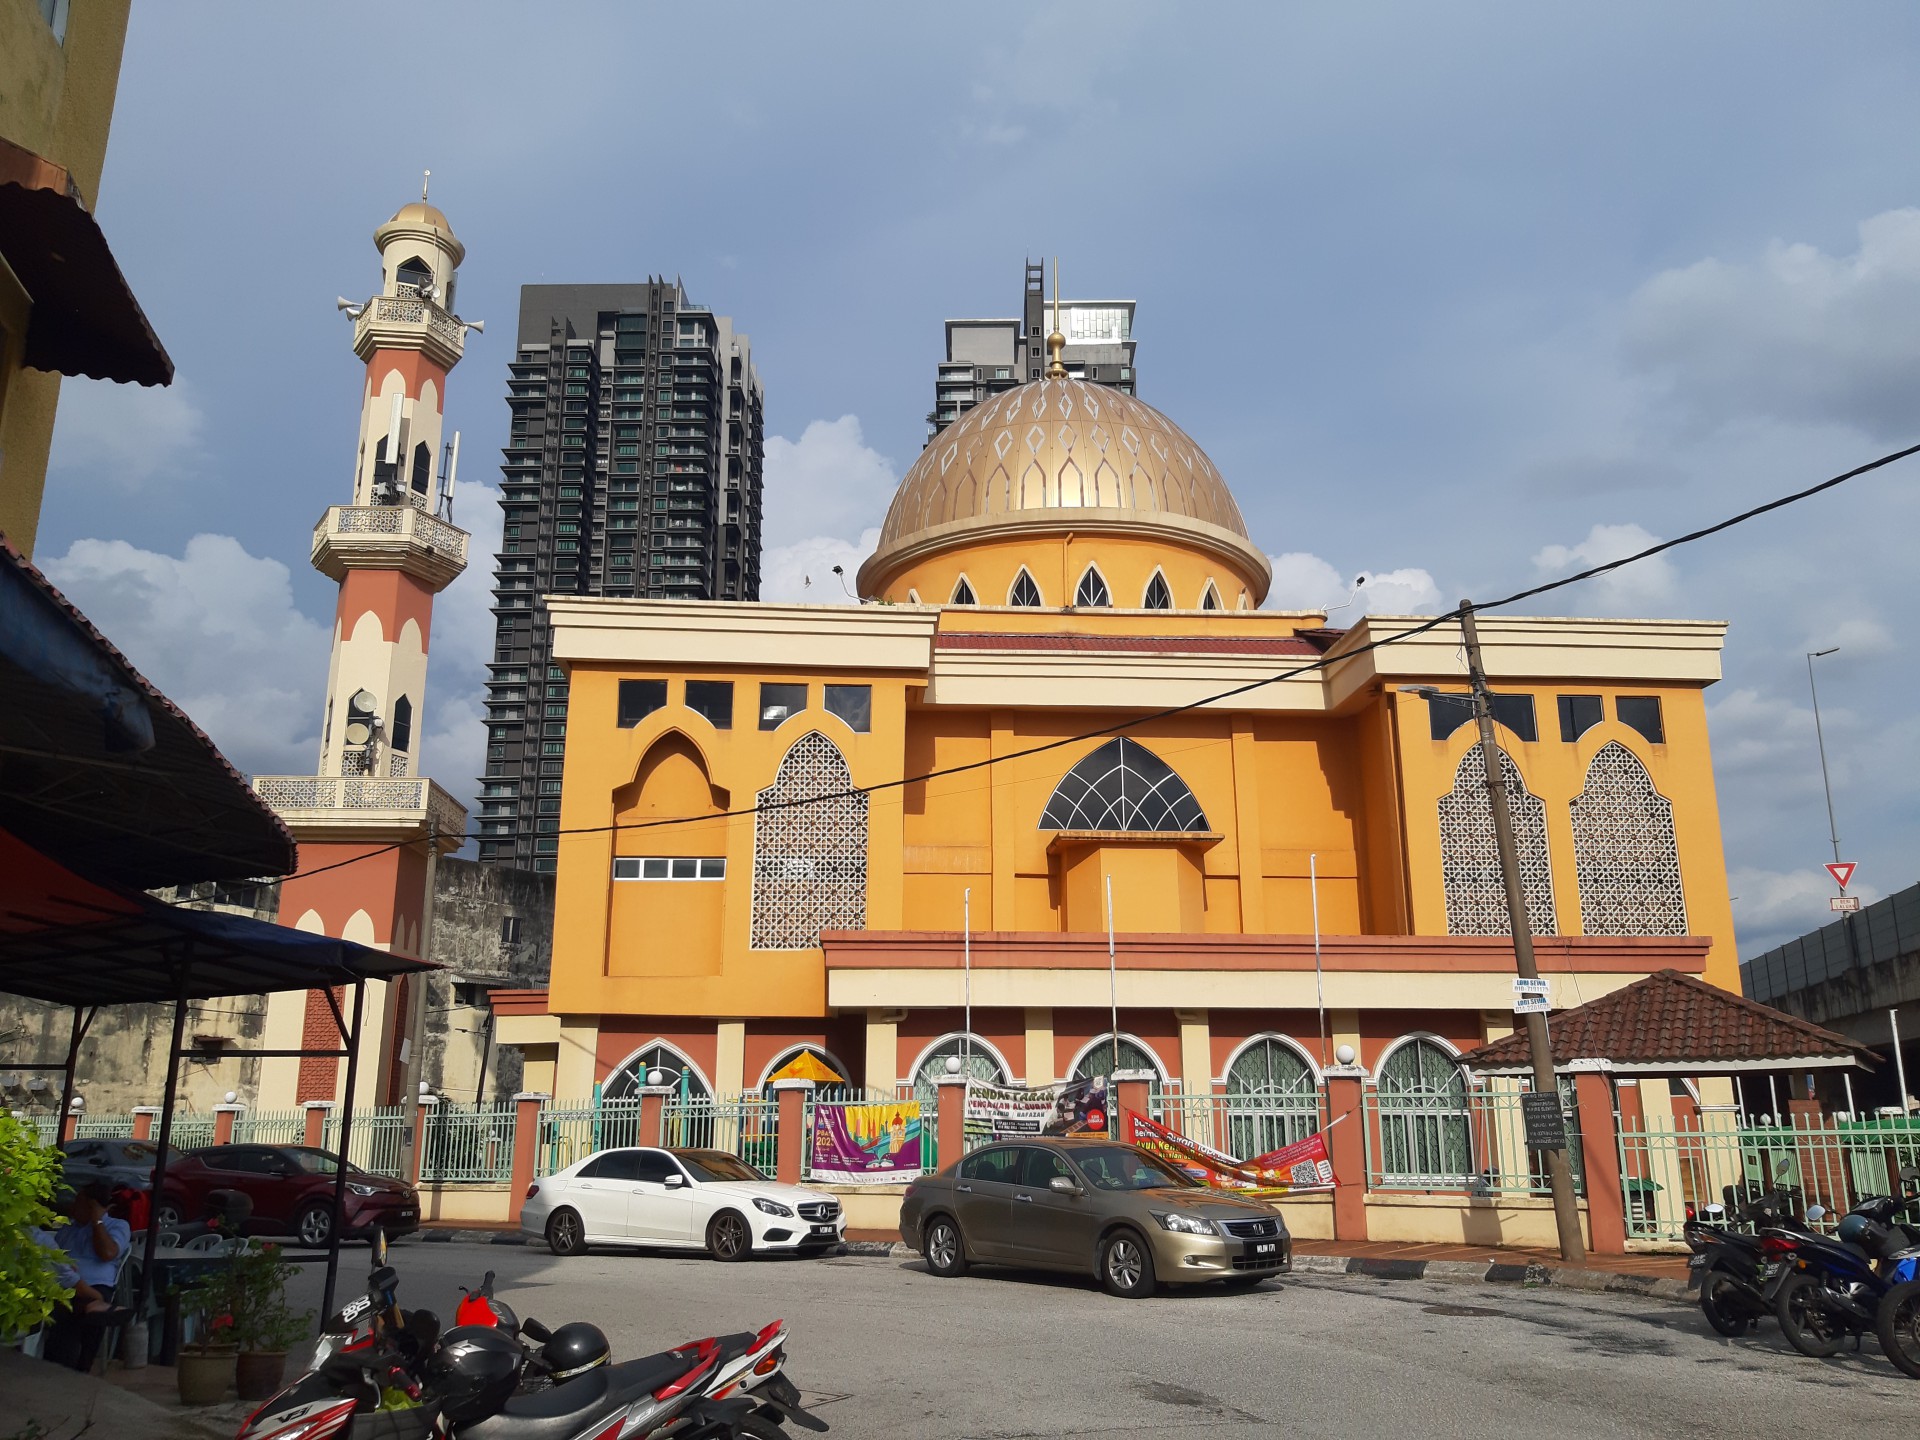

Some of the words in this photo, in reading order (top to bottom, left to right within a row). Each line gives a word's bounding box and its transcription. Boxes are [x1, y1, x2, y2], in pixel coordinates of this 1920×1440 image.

[1530, 997, 1547, 1005] SEWA
[969, 1086, 1056, 1102] PENDAFTARAN
[1012, 1102, 1052, 1110] AL-QURAN
